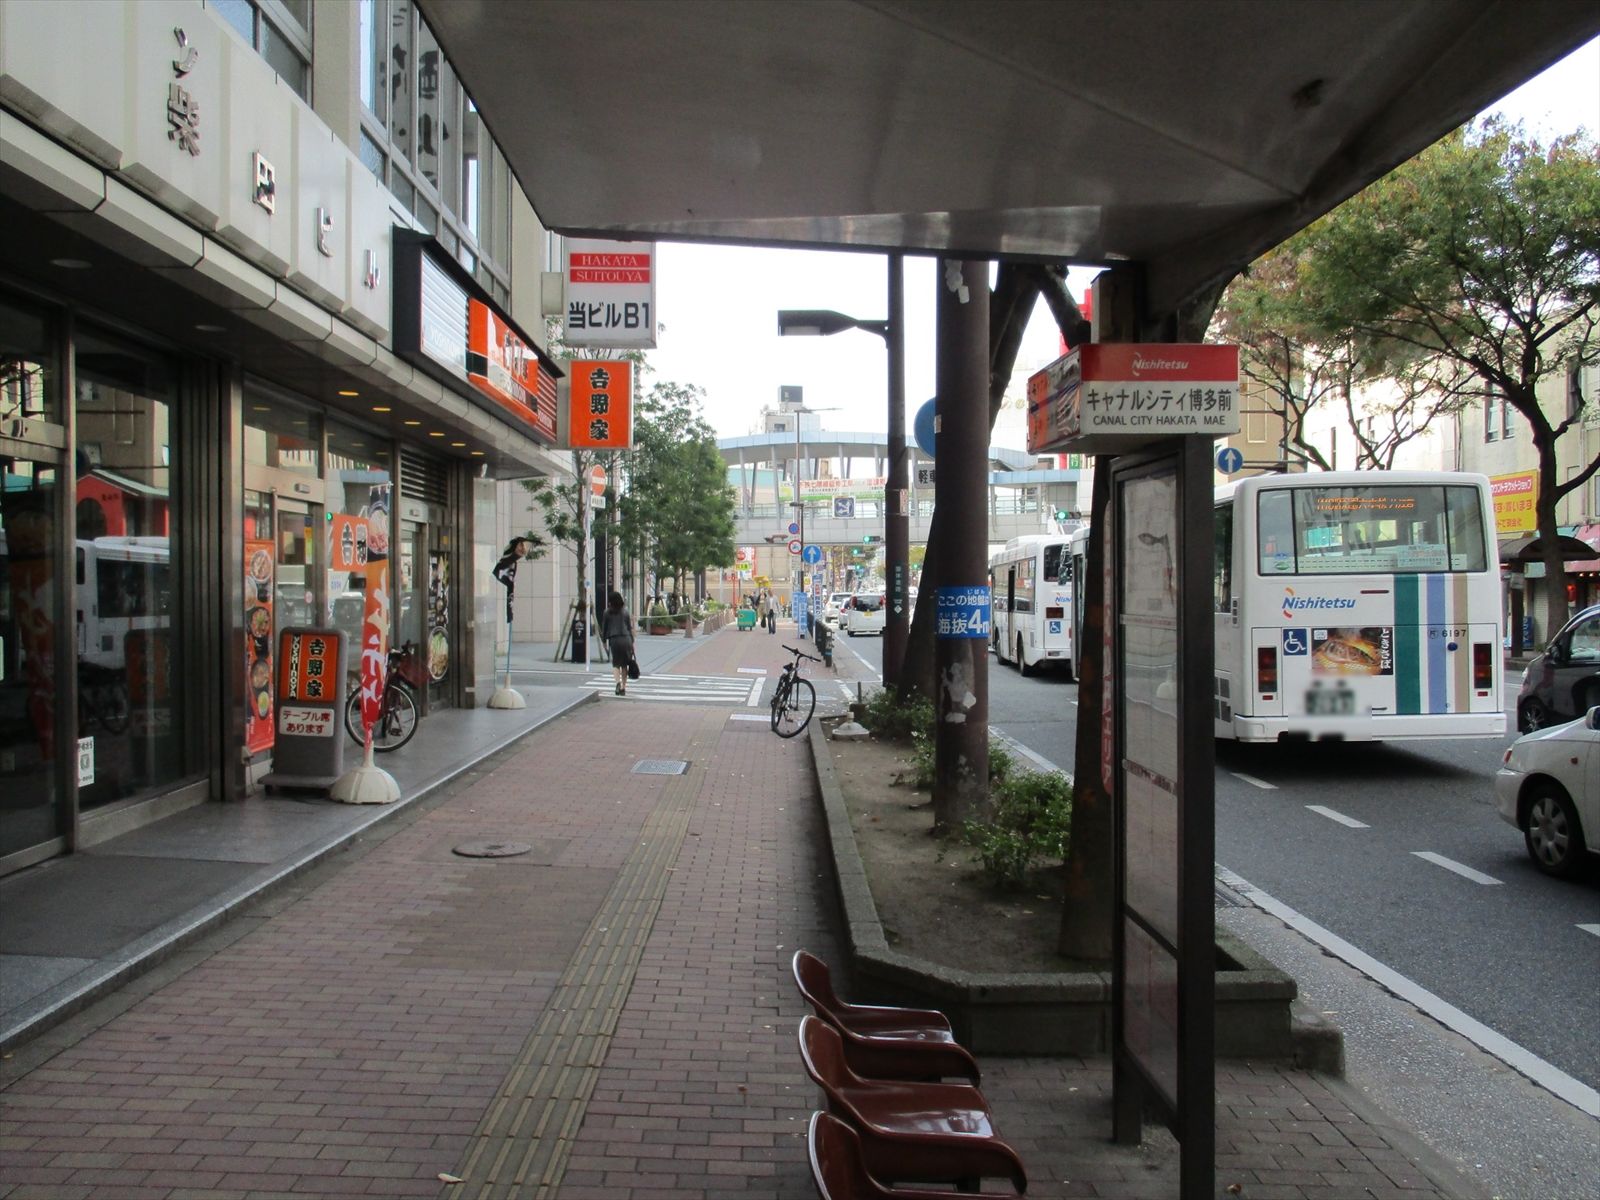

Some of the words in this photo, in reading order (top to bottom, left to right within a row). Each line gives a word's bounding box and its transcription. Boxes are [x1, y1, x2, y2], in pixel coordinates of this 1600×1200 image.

[582, 255, 637, 266] HAKATA
[577, 270, 643, 282] SUITOUYA
[569, 301, 650, 330] 当ビルB1
[1132, 356, 1189, 373] Nishitetsu
[590, 367, 609, 441] 吉野家
[1087, 388, 1232, 412] キャナルシティ博多前
[1093, 415, 1126, 426] CANAL
[1130, 415, 1152, 426] CITY
[1156, 415, 1197, 426] HAKATA
[1203, 415, 1225, 426] MAE
[1281, 593, 1356, 612] Nishitetsu
[1442, 629, 1466, 637] 6197
[307, 638, 325, 698] 吉野家
[283, 710, 330, 722] テーブル席
[286, 723, 324, 734] あります
